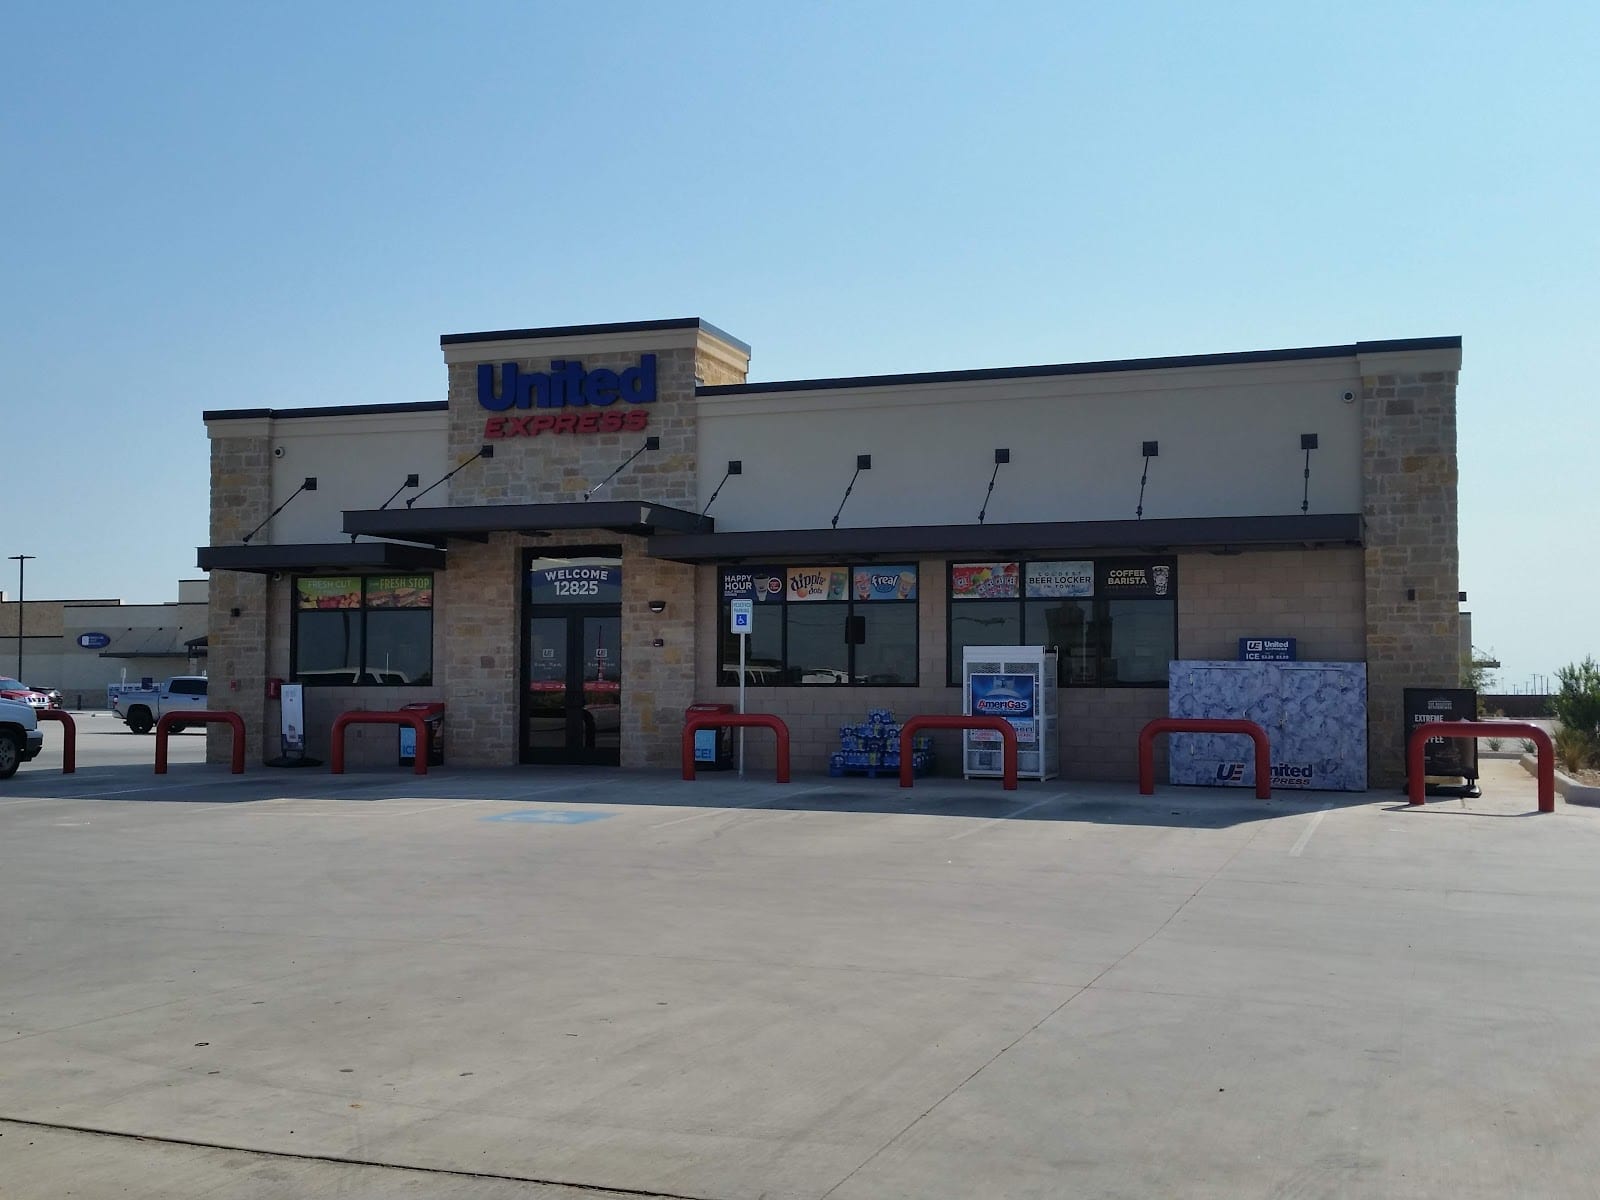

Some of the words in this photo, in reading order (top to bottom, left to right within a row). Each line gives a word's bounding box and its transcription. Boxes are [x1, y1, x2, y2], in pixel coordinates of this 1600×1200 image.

[477, 353, 657, 412] United
[484, 409, 650, 439] EXPRESS
[545, 569, 609, 581] WELCOME
[1110, 569, 1145, 577] COFFEE
[307, 580, 333, 589] FRESH
[335, 580, 352, 588] CUT
[380, 578, 406, 589] FRESH
[409, 577, 430, 589] STOP
[1054, 576, 1091, 584] LOCKER
[1107, 577, 1148, 585] BARISTA
[554, 581, 599, 596] 12825
[724, 582, 752, 590] HOUR
[977, 699, 1028, 710] AmeriGas
[1414, 714, 1444, 723] EXTREME
[1216, 763, 1245, 781] UE
[1270, 763, 1313, 778] nited
[1270, 777, 1310, 785] PRESS
